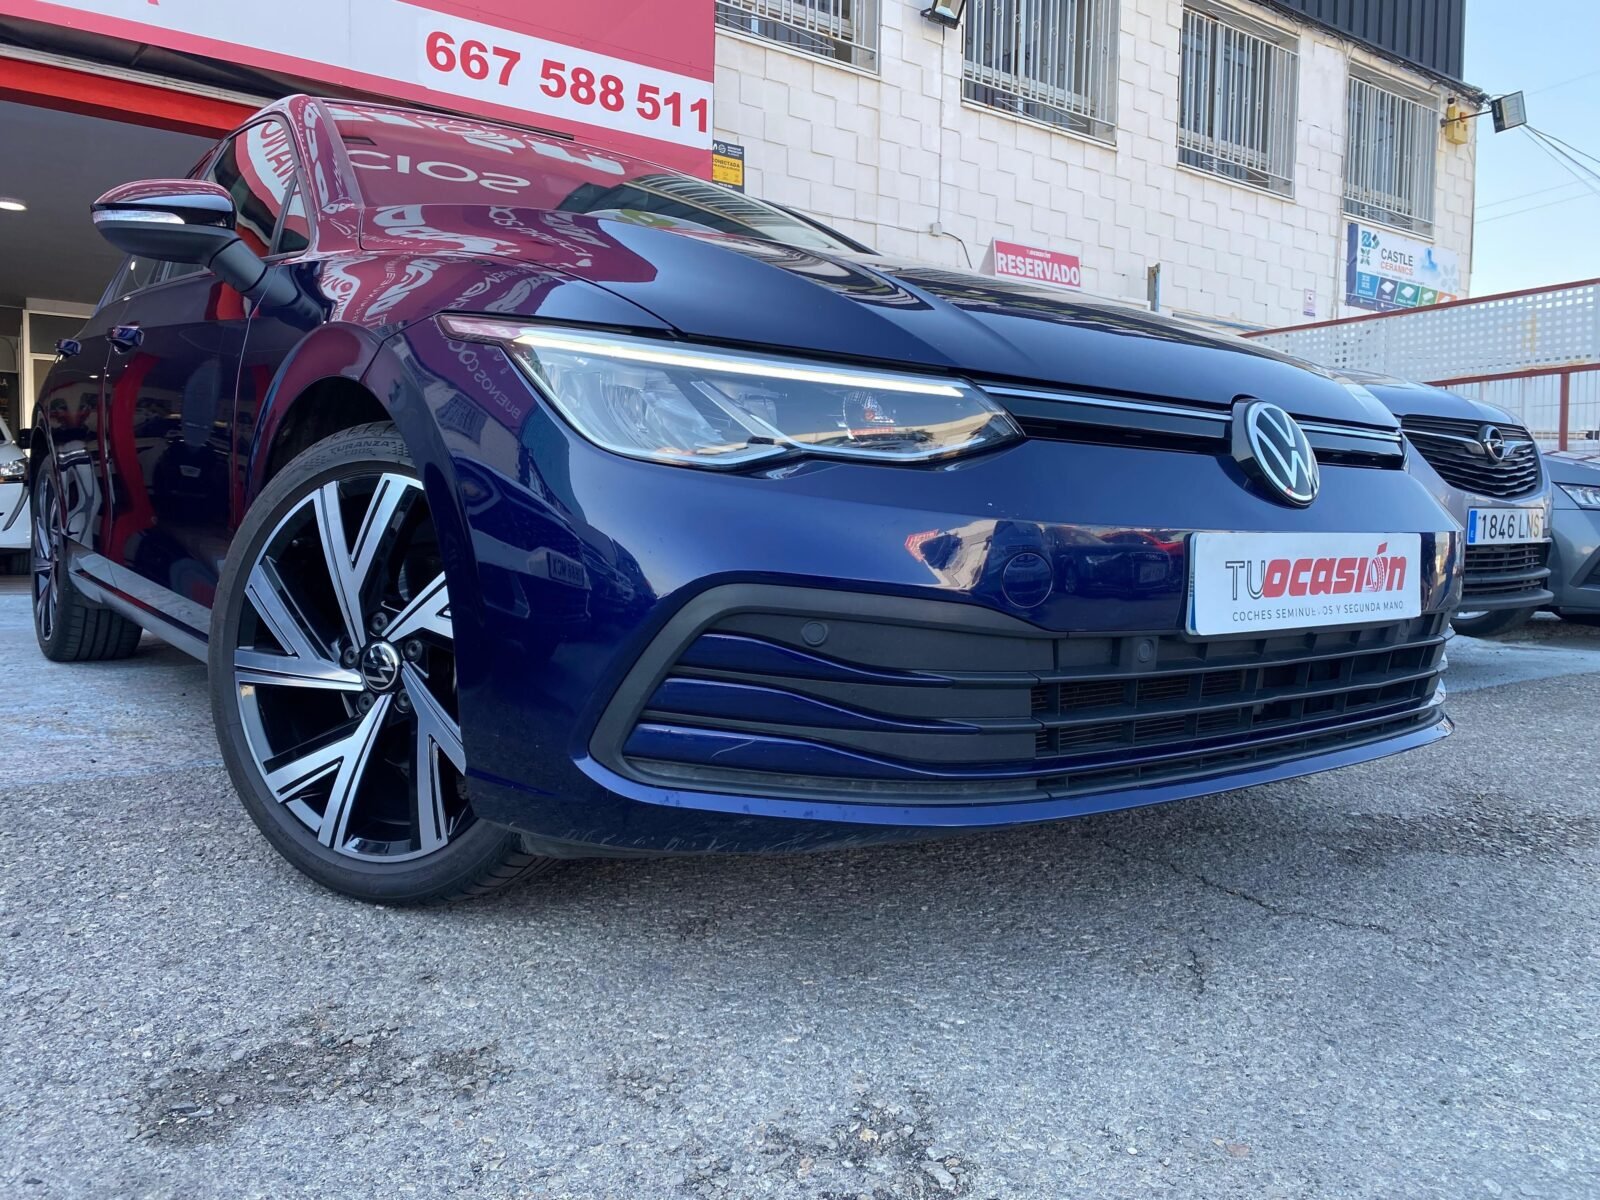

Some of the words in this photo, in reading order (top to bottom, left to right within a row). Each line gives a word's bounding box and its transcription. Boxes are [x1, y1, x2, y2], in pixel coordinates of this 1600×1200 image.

[425, 31, 521, 86] 667
[539, 58, 625, 113] 588
[635, 83, 708, 133] 511
[996, 252, 1080, 285] RESERVADO
[1380, 248, 1414, 267] CASTLE
[1380, 262, 1414, 276] CERAMICS
[1482, 514, 1515, 539] 1846
[1518, 514, 1540, 538] LNS
[1232, 609, 1272, 622] COCHES
[1336, 604, 1341, 614] Y
[1344, 602, 1381, 614] SEGUNDA
[1383, 600, 1404, 611] MANO
